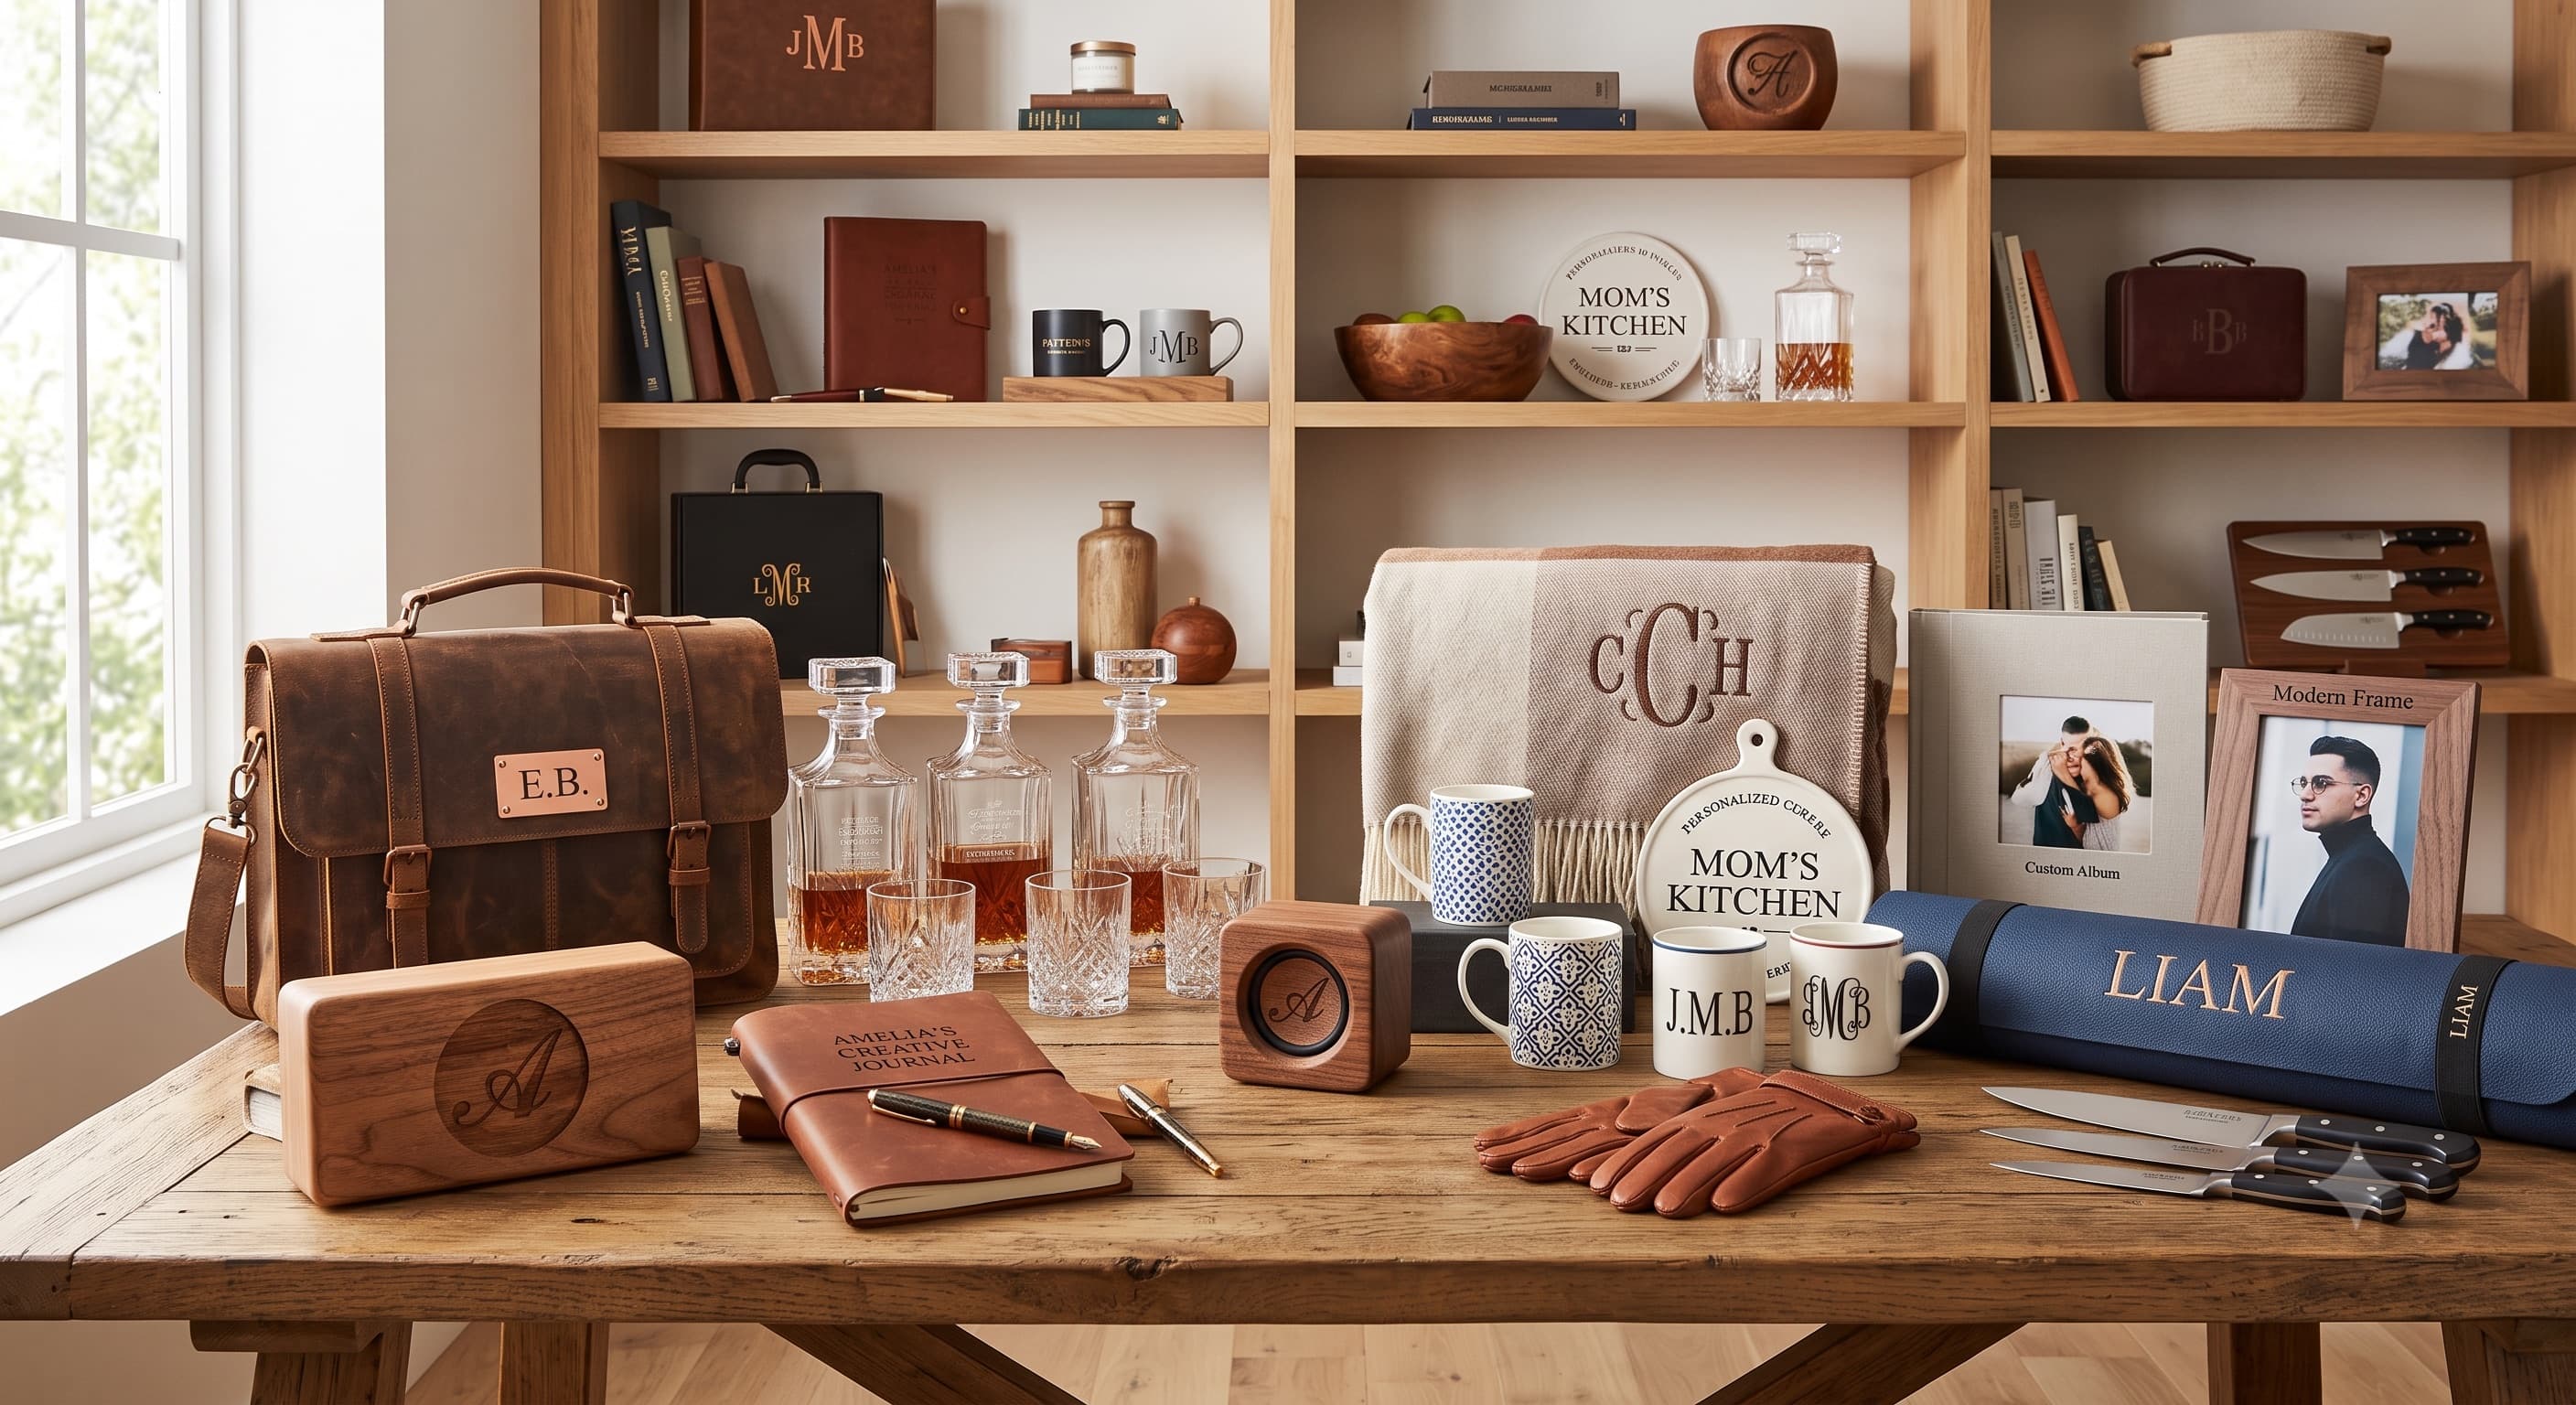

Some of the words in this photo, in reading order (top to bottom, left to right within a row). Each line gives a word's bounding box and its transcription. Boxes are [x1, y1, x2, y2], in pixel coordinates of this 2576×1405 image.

[786, 15, 864, 71] JMB
[1562, 315, 1687, 336] KITCHEN
[1149, 329, 1198, 364] JMB
[753, 563, 812, 606] LMR
[2272, 684, 2345, 705] Modern
[2352, 689, 2414, 709] Frame
[518, 767, 588, 799] E.B.
[2025, 861, 2074, 876] Custom
[2077, 864, 2120, 880] Album
[1667, 884, 1841, 918] KITCHEN
[2104, 949, 2295, 1019] LIAM
[2449, 984, 2479, 1039] LIAM
[834, 1025, 957, 1046] AMELIA'S
[838, 1038, 970, 1059] CREATIVE
[854, 1052, 975, 1072] JOURNAL
